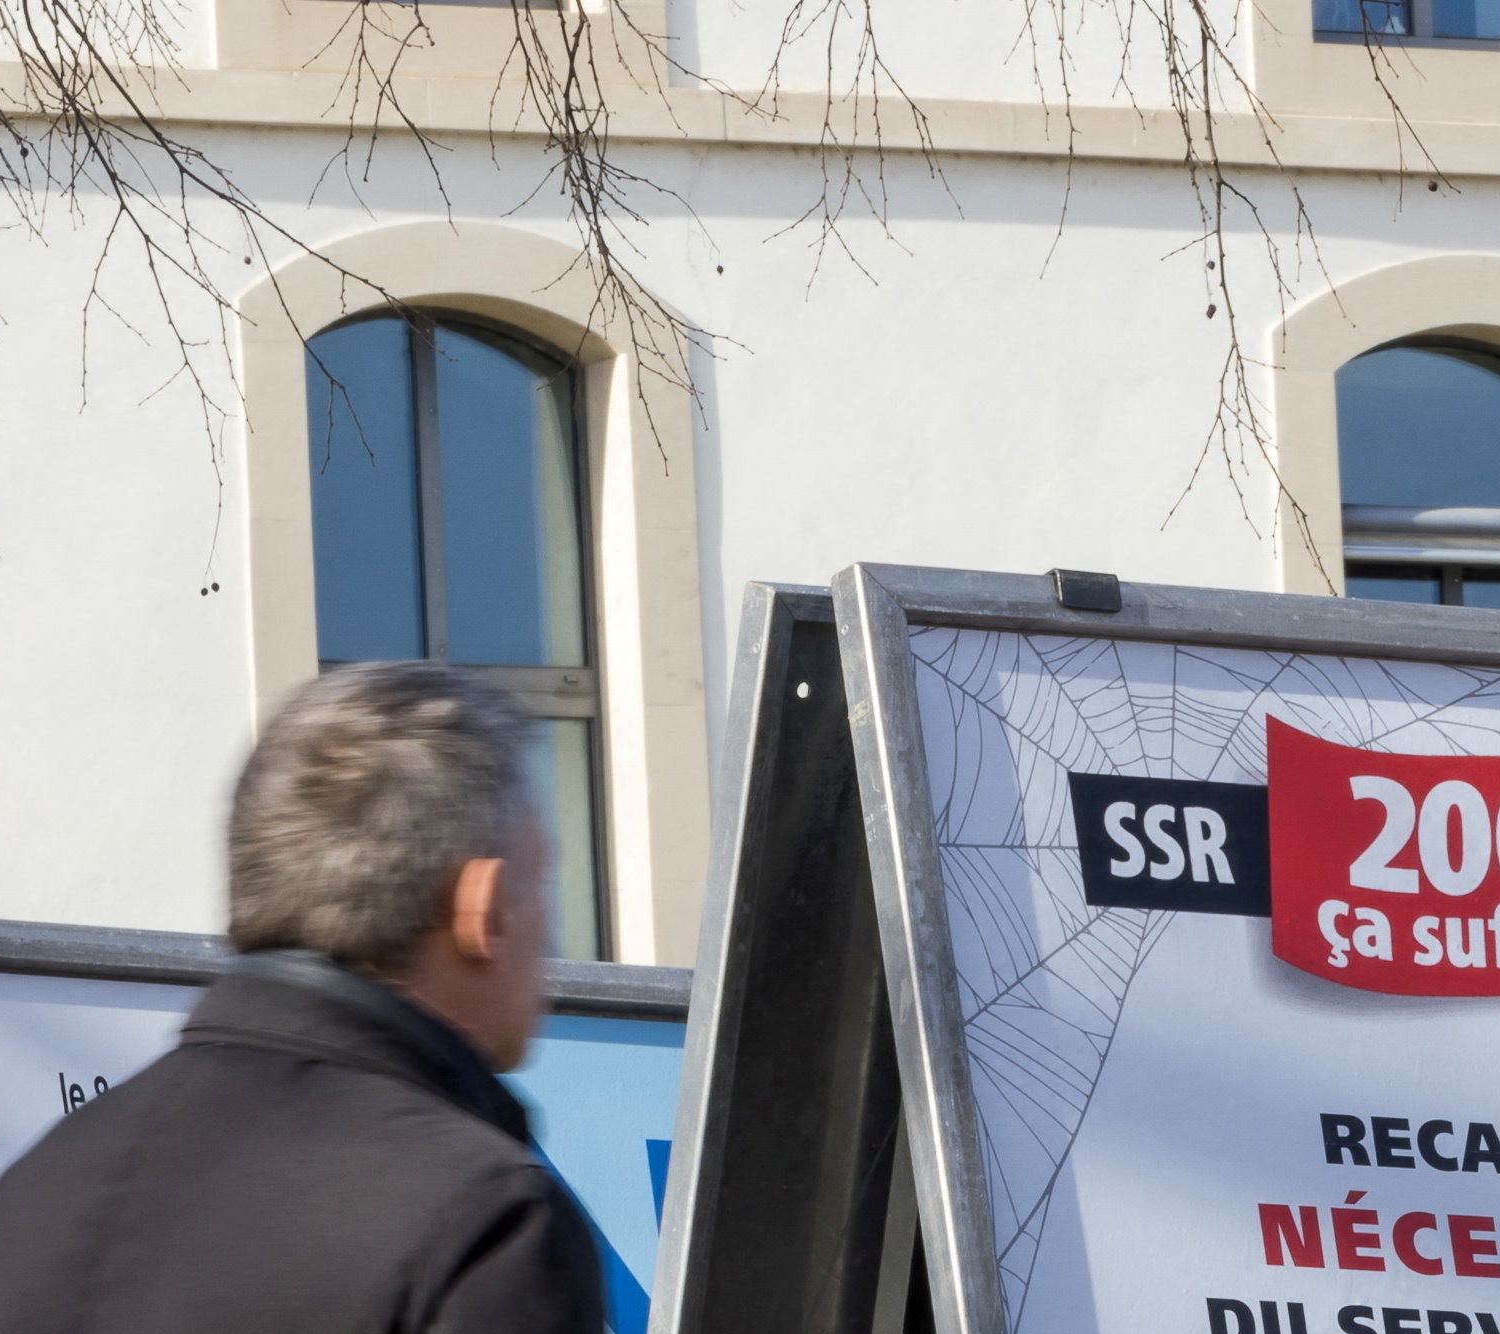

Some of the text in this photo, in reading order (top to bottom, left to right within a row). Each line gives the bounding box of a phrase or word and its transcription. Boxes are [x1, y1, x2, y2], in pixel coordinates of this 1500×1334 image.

[1103, 800, 1236, 886] SSR
[1318, 900, 1393, 968] ça
[59, 1072, 86, 1114] le
